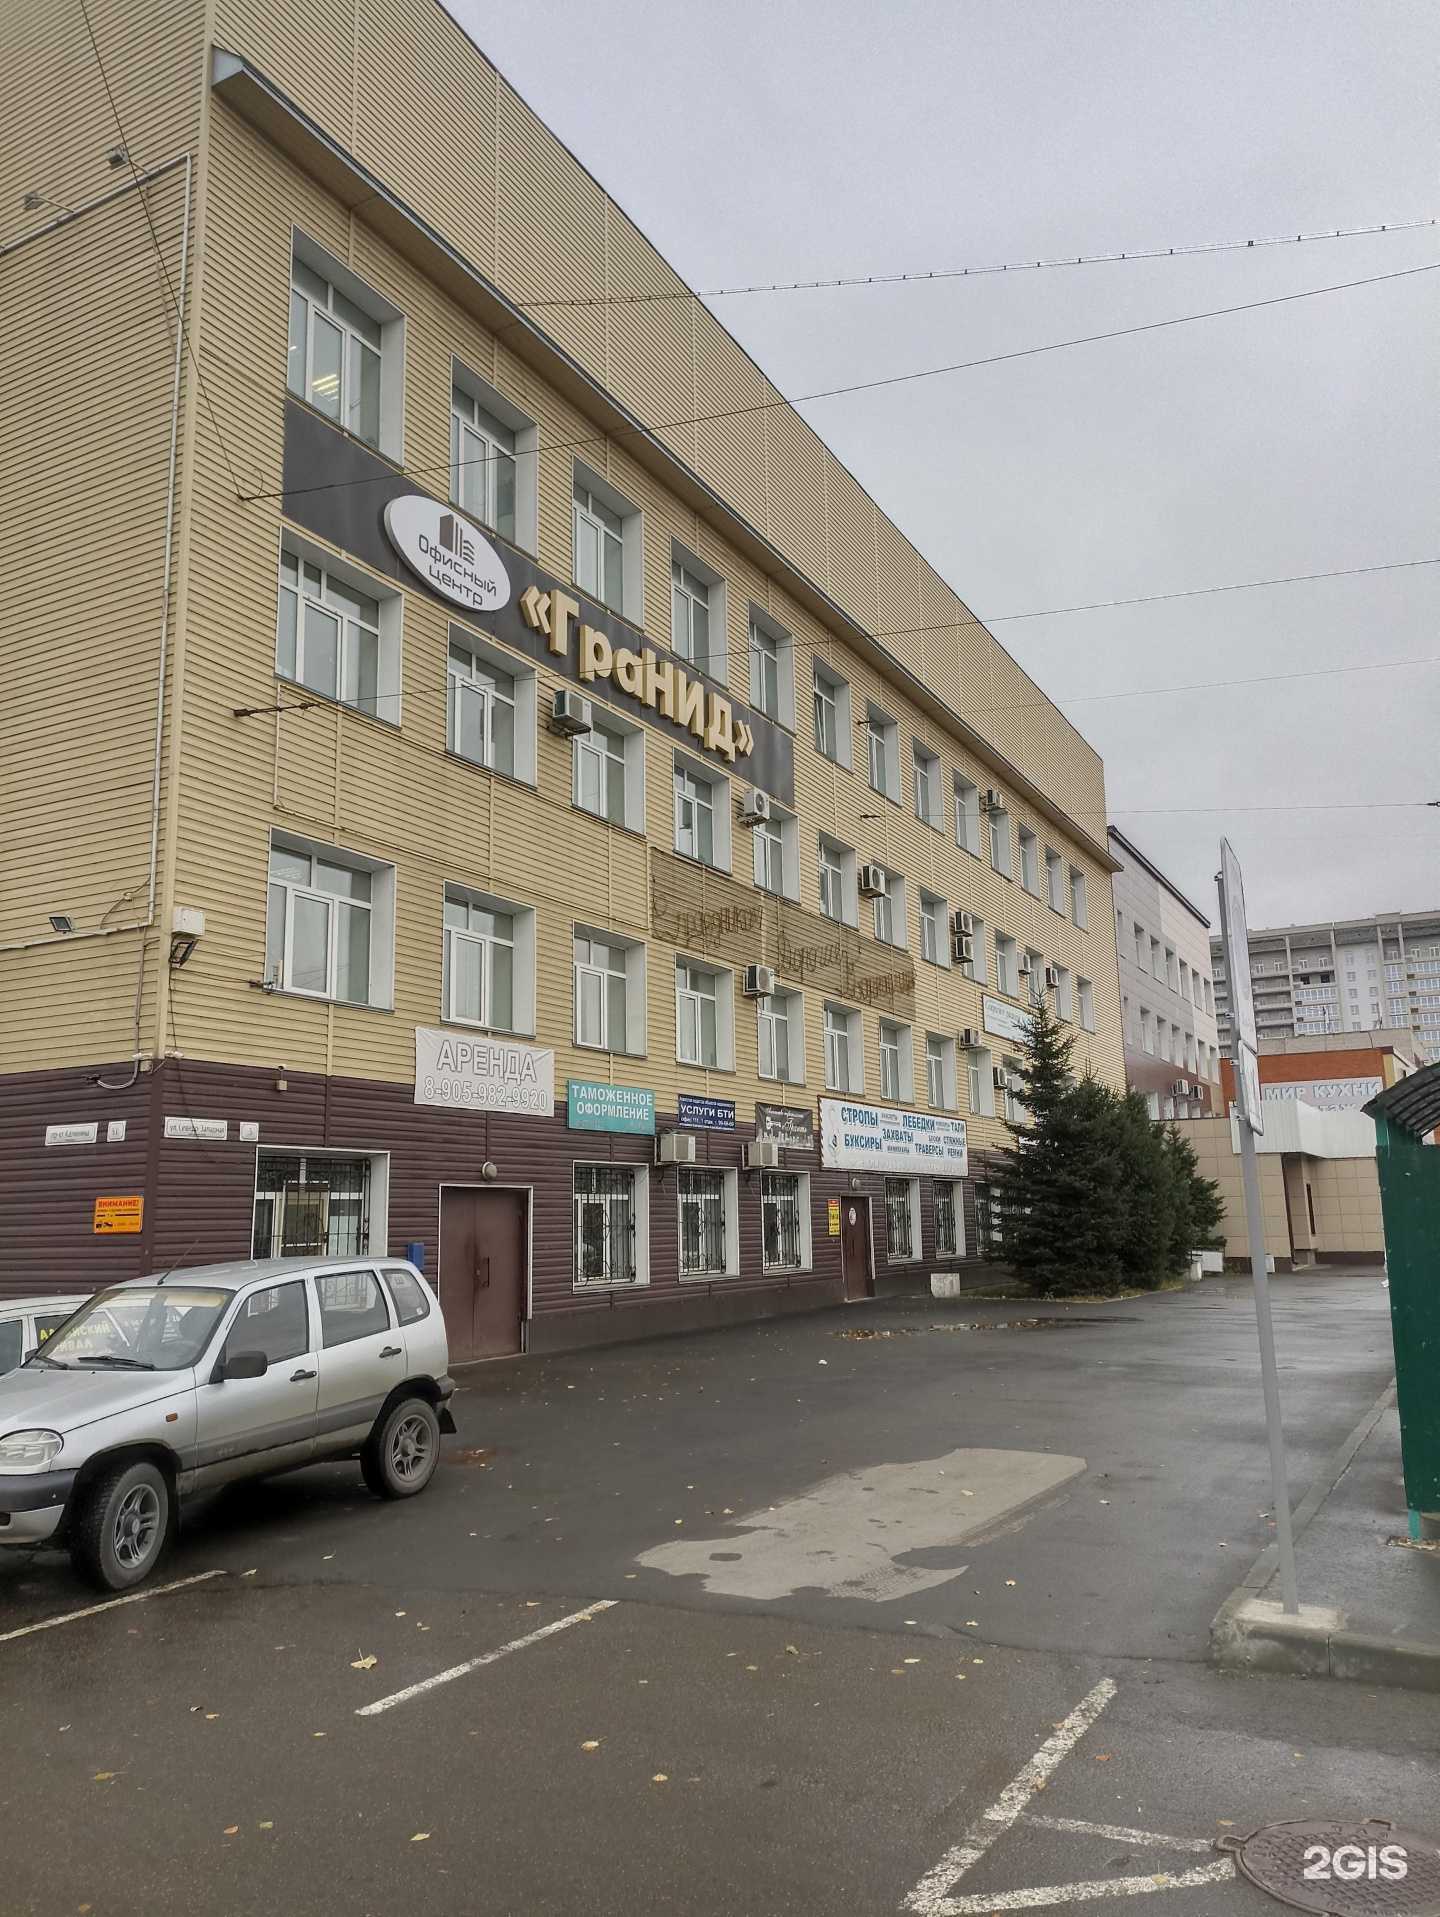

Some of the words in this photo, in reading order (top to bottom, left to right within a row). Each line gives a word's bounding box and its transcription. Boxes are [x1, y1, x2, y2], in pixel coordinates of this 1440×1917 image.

[418, 533, 498, 597] Офисный
[429, 564, 484, 606] центр
[436, 1039, 538, 1085] АРЕНДА
[424, 1075, 547, 1111] 8-905-982-9920
[571, 1084, 653, 1106] ТАМОЖЕННОЕ
[1264, 1087, 1306, 1101] МИР
[1312, 1081, 1380, 1099] КУХНИ
[576, 1101, 650, 1121] ОФОРМЛЕНИЕ
[680, 1104, 715, 1117] УСЛУГИ
[717, 1109, 734, 1119] БТИ
[841, 1106, 878, 1126] СТРОПЫ
[902, 1114, 936, 1132] ЛЕБЕДКИ
[844, 1133, 882, 1150] БУКСИРЫ
[915, 1143, 944, 1156] ТРАВЕРСЫ
[882, 1128, 913, 1143] ЗАХВАТЫ
